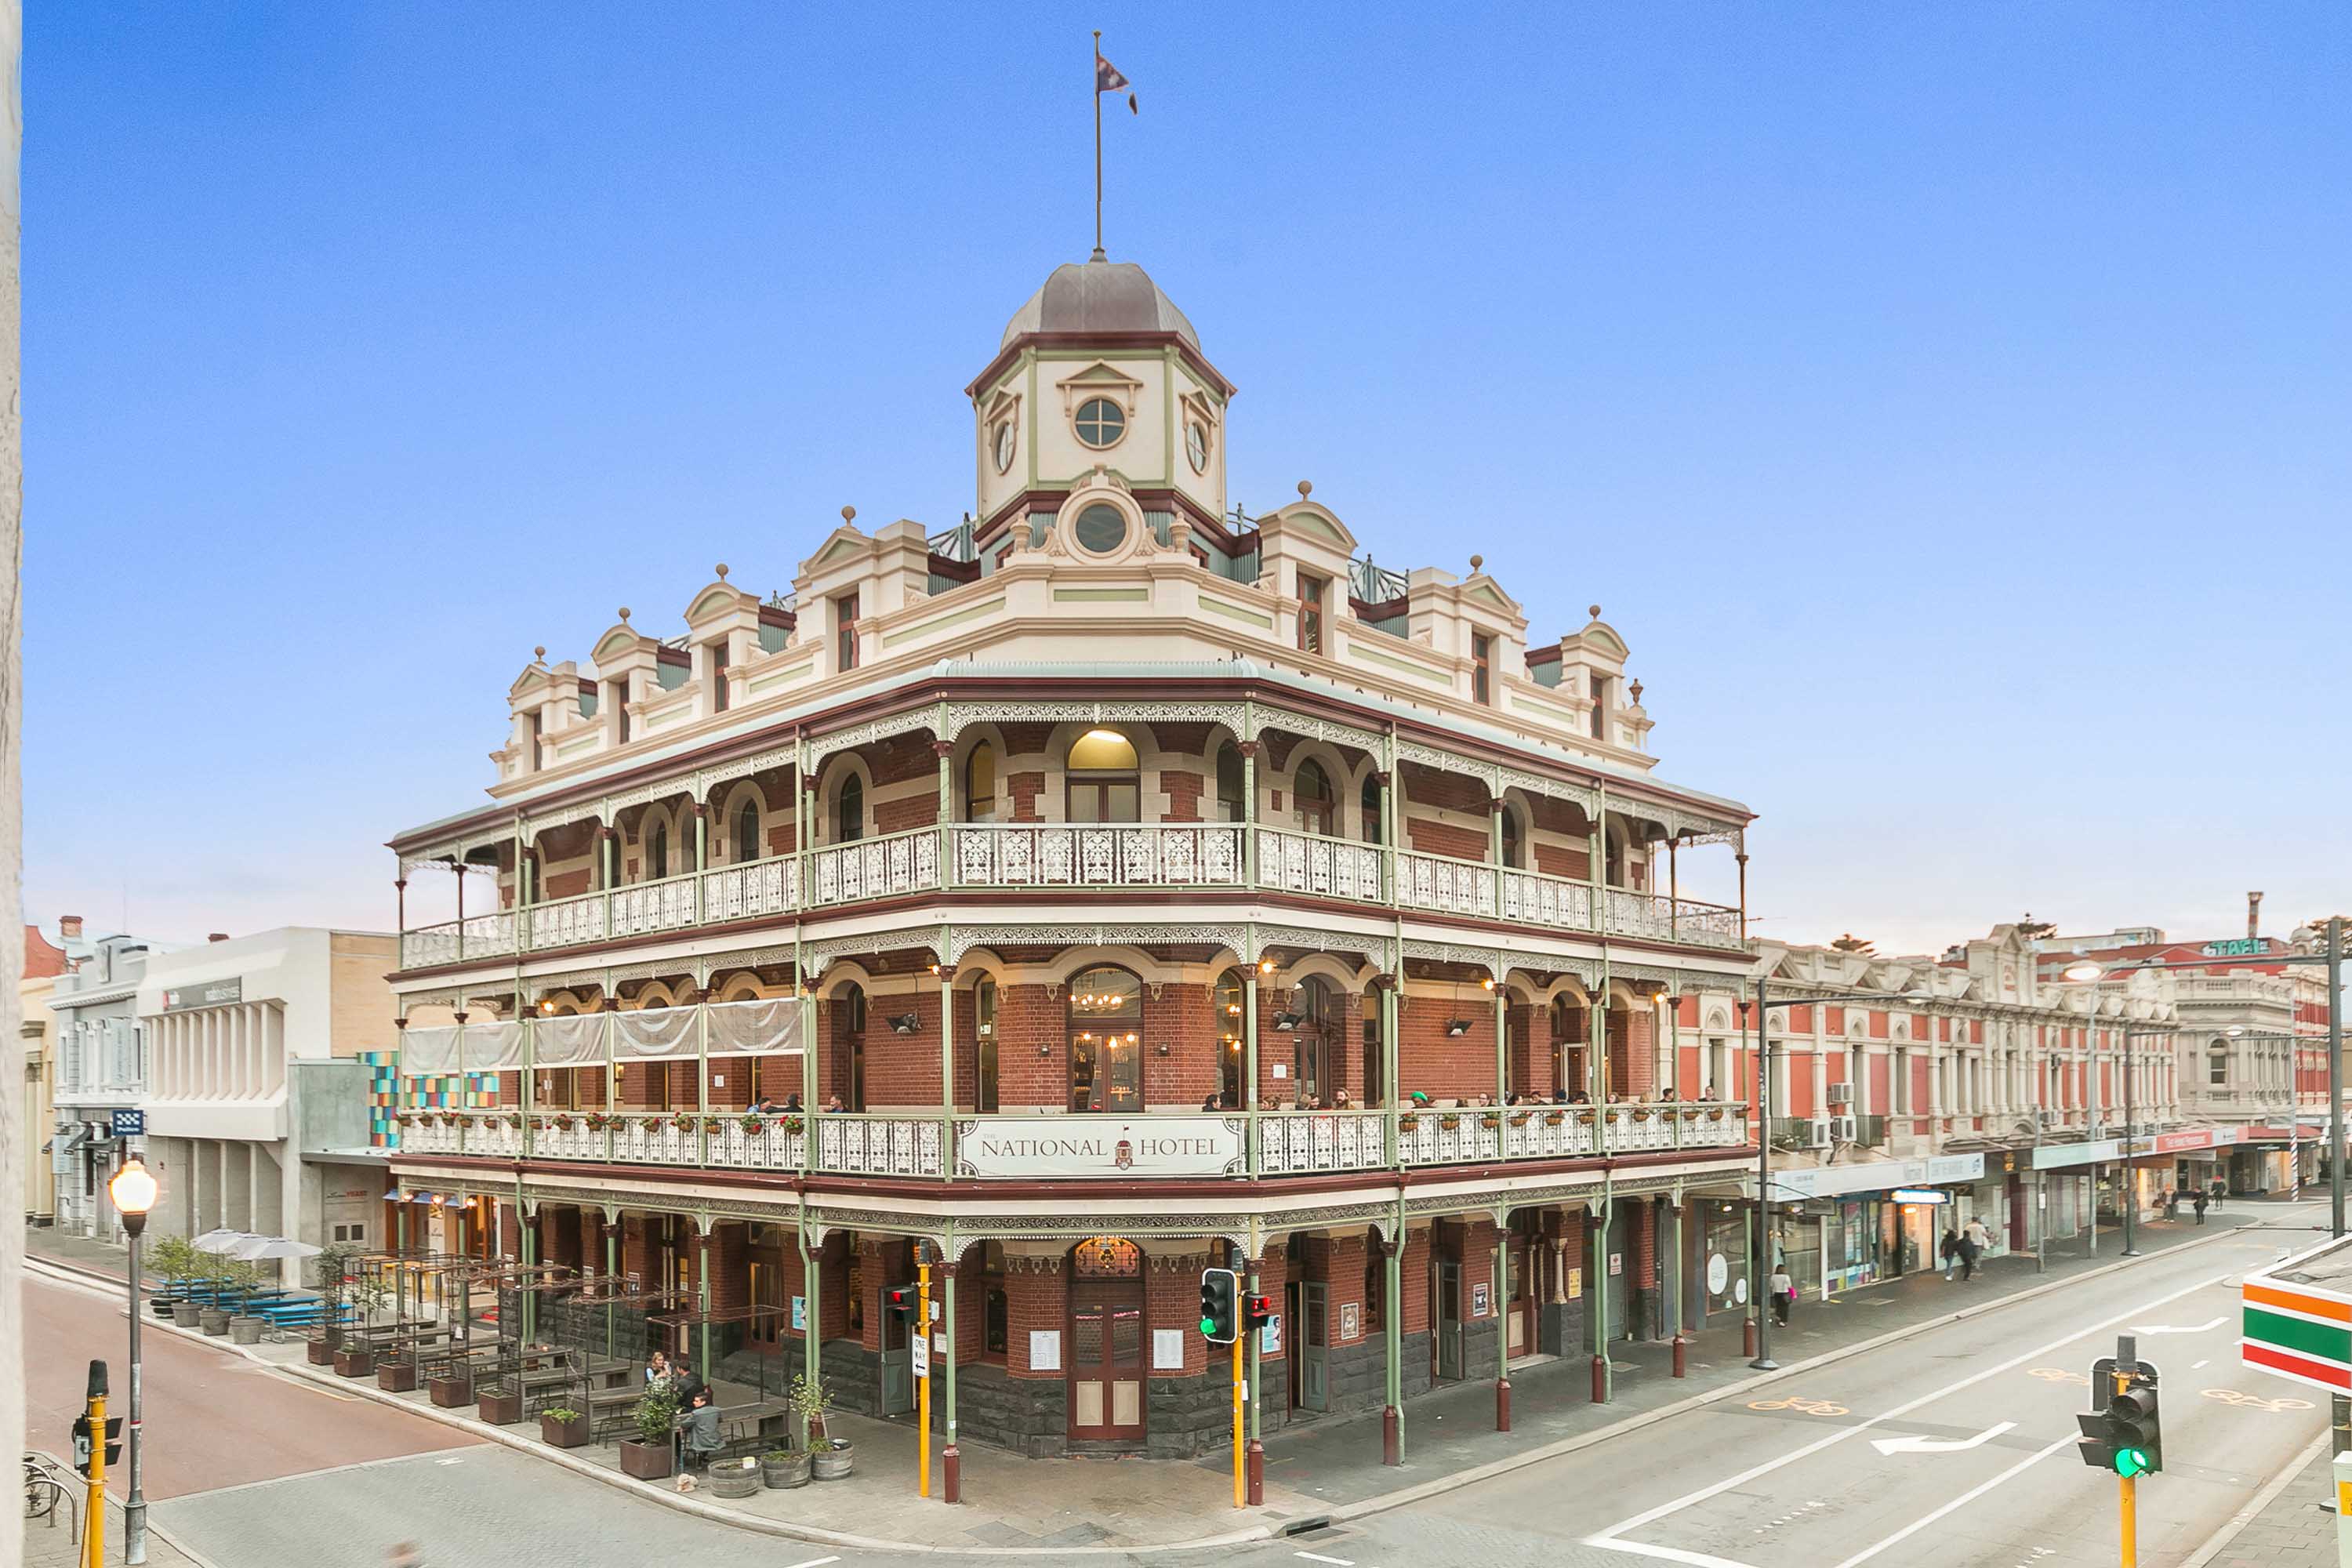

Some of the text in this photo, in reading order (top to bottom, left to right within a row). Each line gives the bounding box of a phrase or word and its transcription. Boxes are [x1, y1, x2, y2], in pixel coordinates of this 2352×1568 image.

[982, 1138, 1221, 1156] NATIONAL HOTEL
[915, 1338, 925, 1349] ONE
